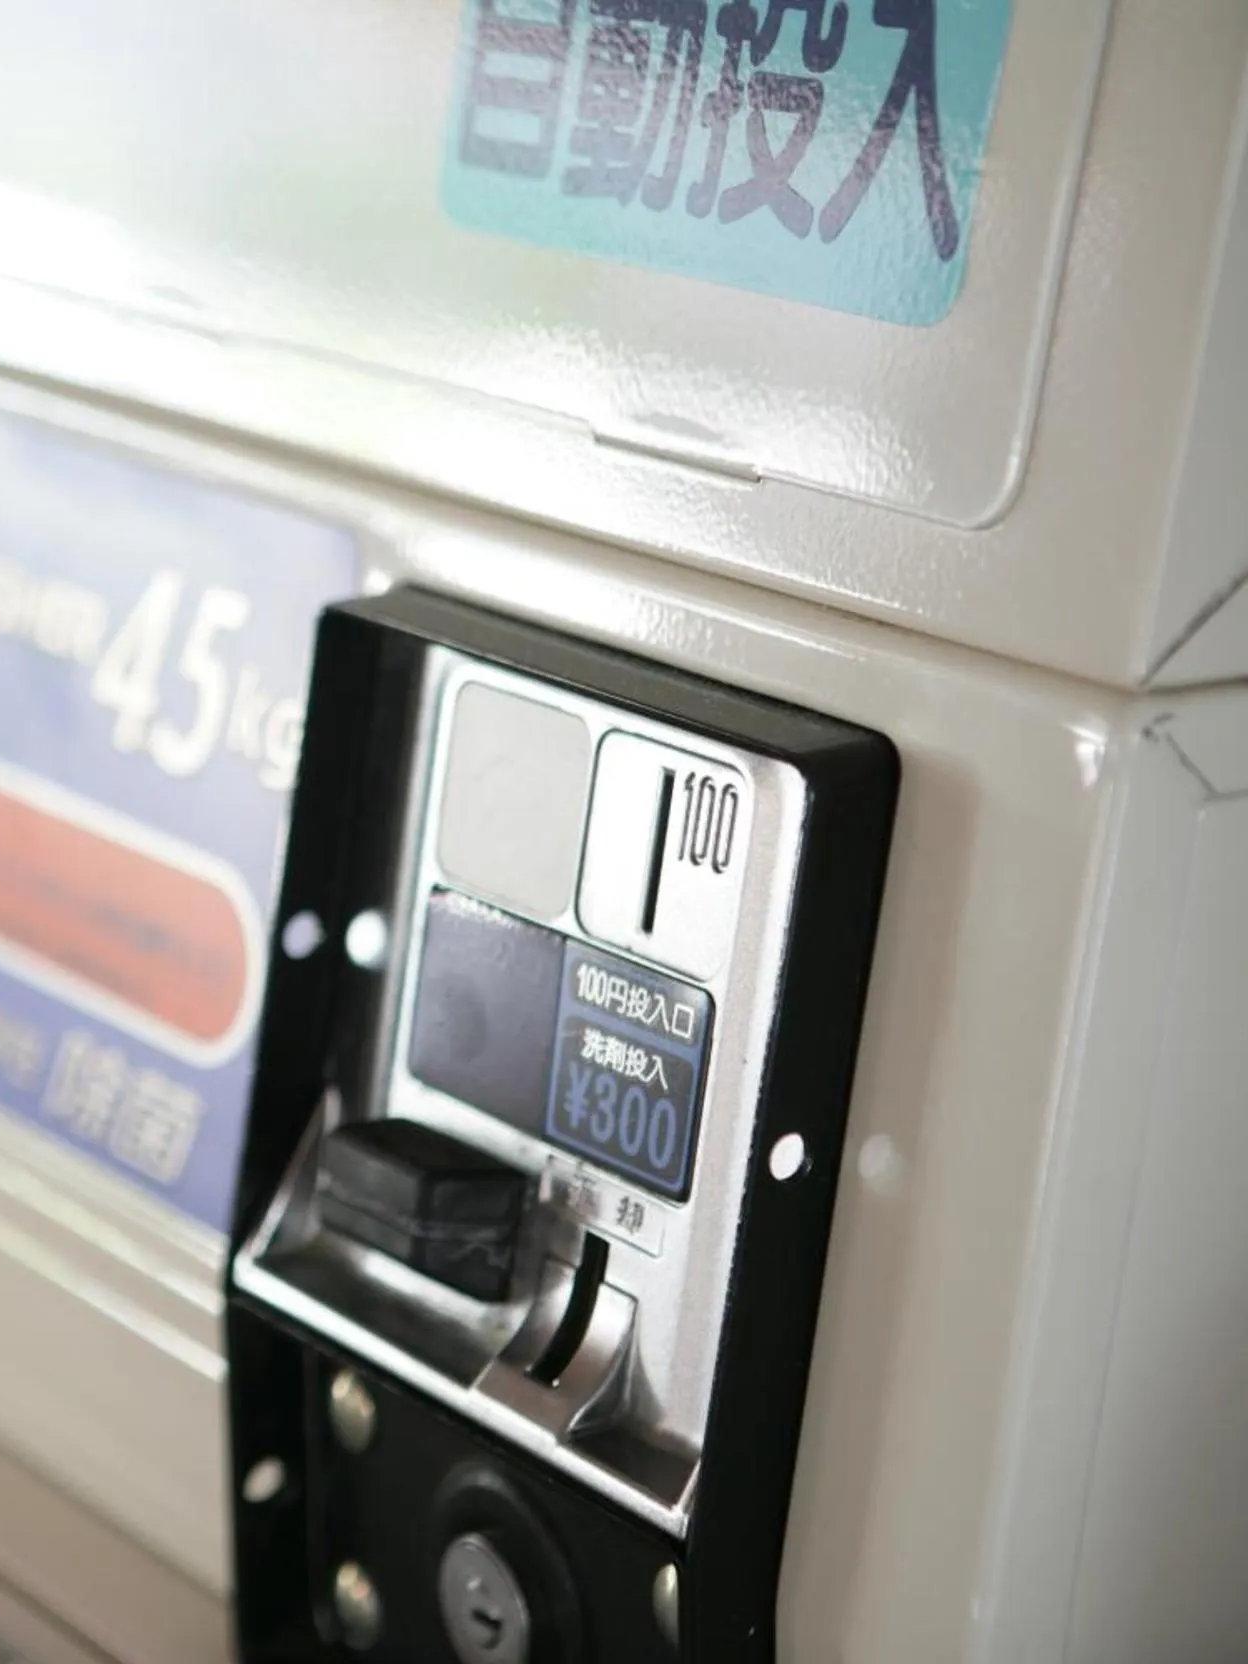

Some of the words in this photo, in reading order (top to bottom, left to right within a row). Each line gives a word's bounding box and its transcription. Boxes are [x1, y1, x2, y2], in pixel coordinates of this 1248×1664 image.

[678, 771, 739, 874] 100
[576, 962, 694, 1039] 100円投入口
[580, 1027, 669, 1091] 洗剤投入
[563, 1061, 677, 1170] ¥300
